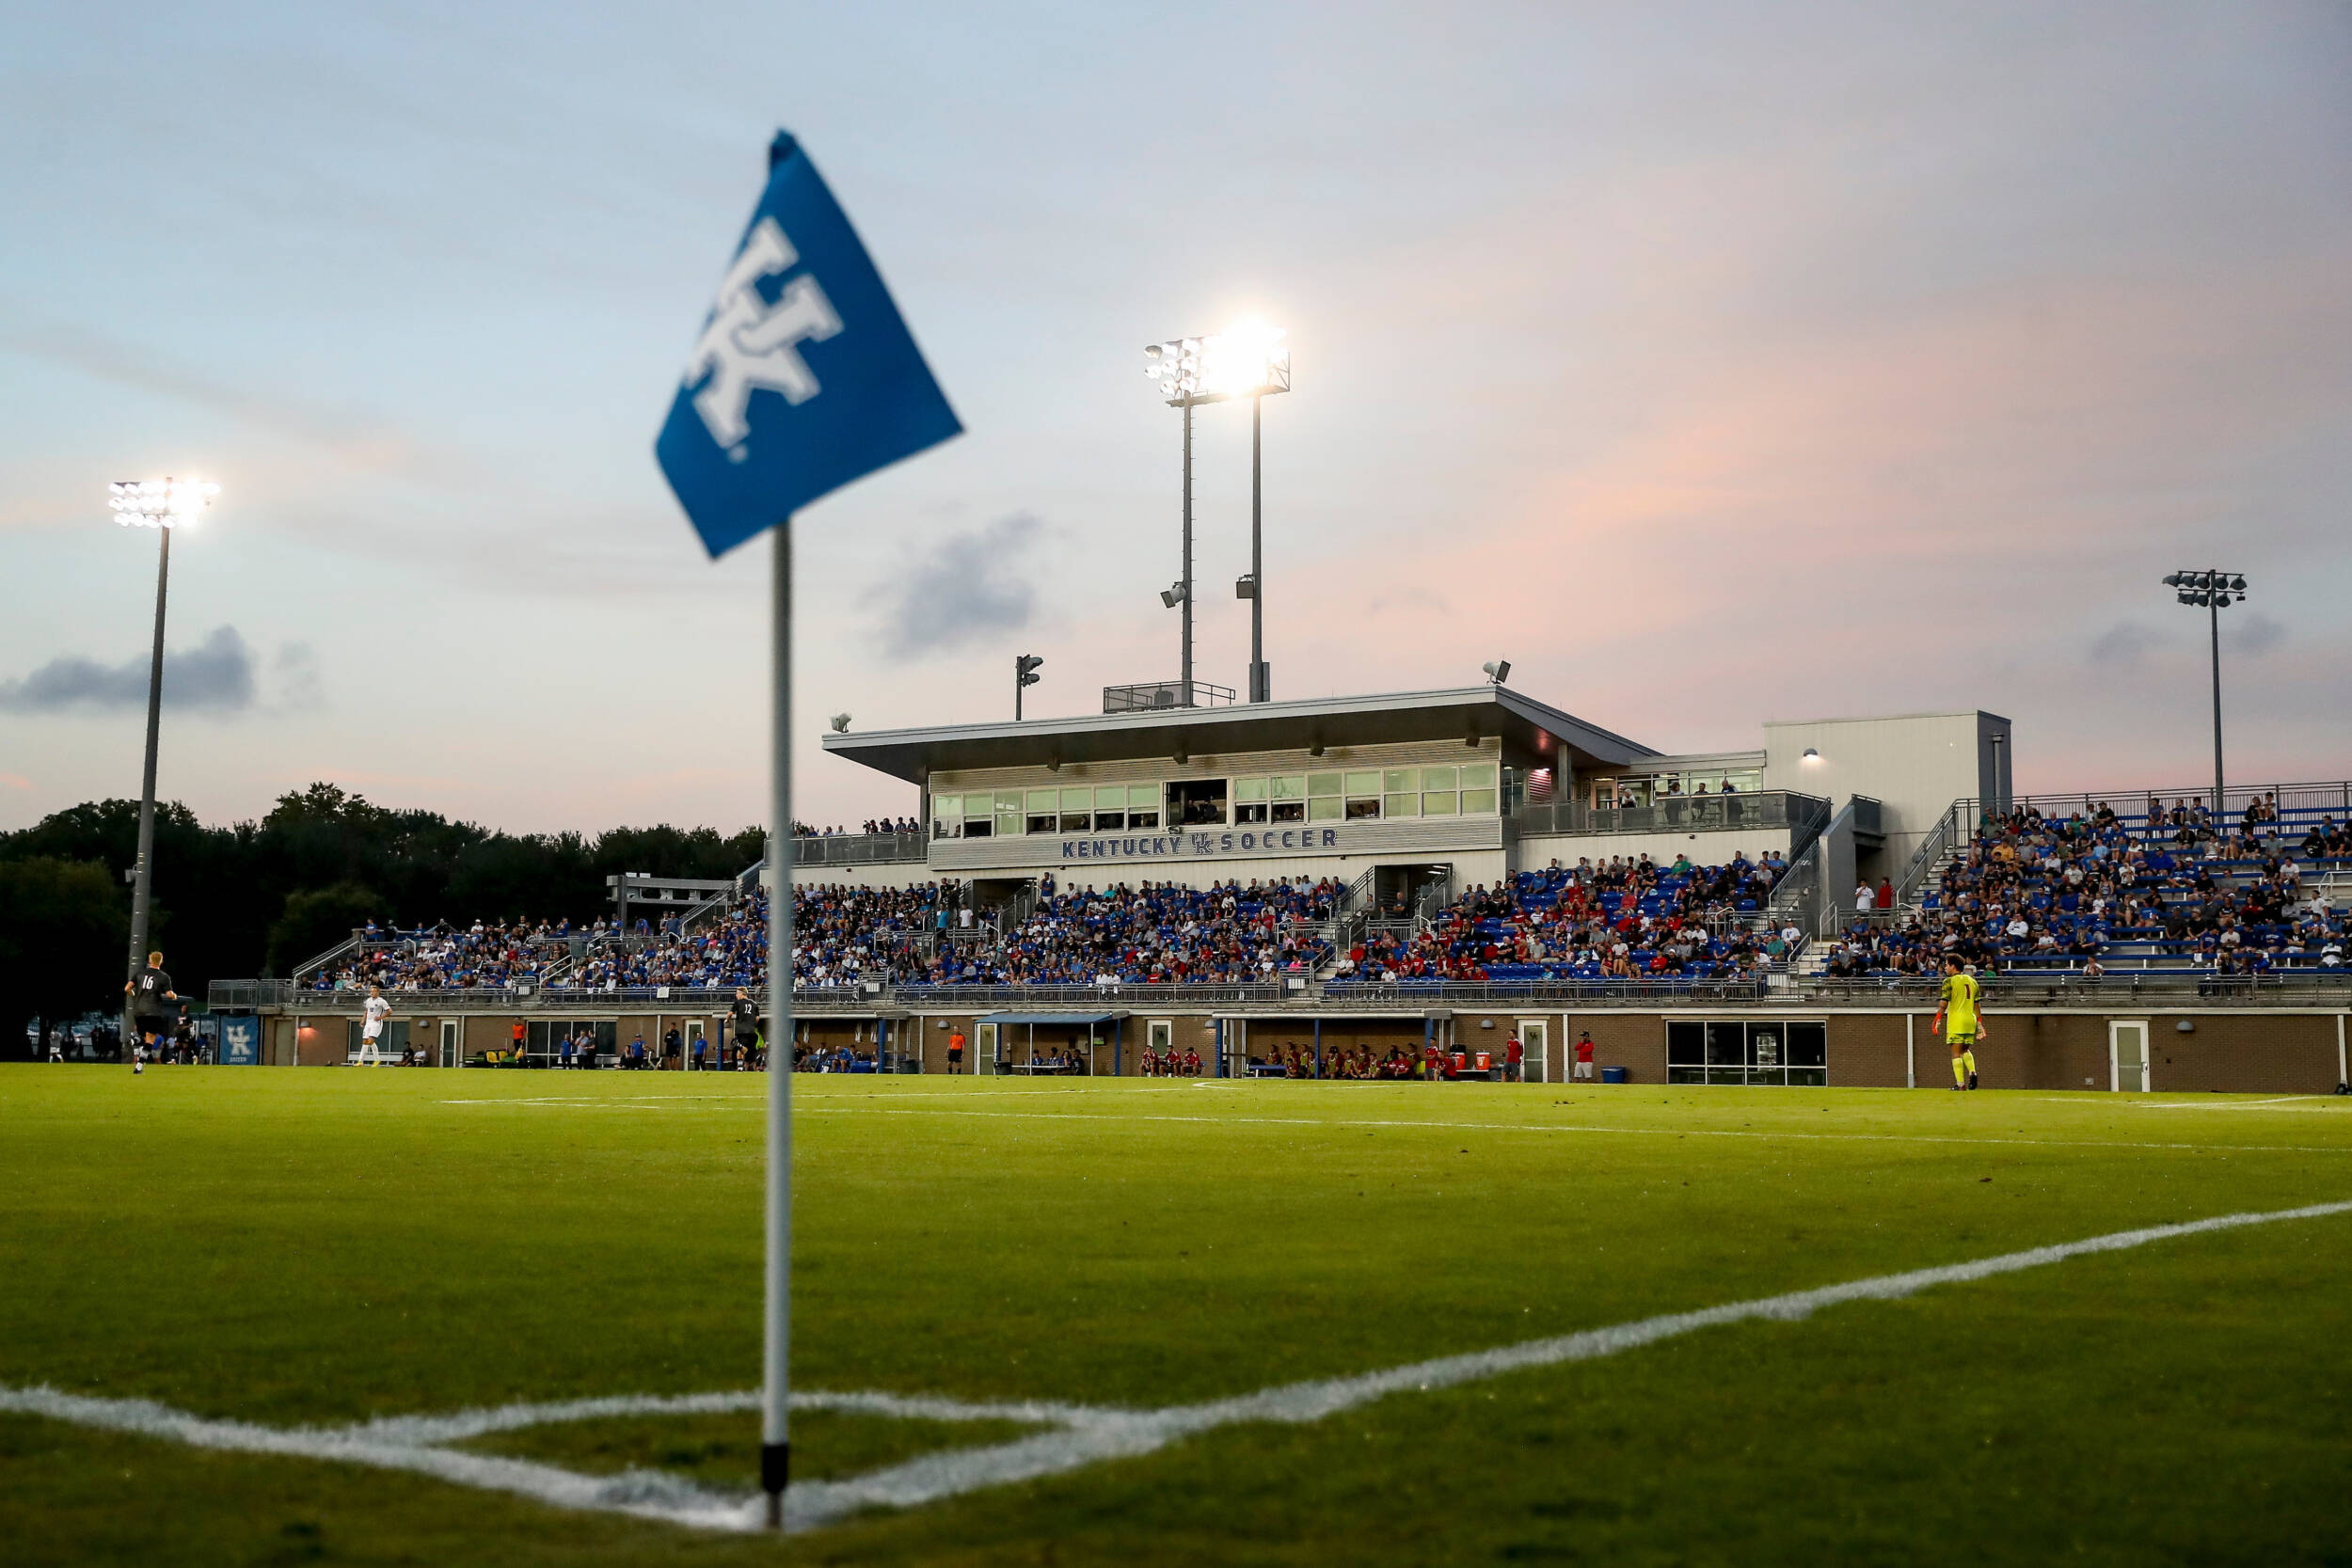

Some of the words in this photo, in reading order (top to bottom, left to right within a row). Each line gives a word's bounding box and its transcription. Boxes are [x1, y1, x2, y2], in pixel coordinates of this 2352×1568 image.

[685, 214, 846, 451] UK
[1061, 835, 1182, 859] KENTUCKY
[1191, 832, 1214, 856] UK
[1219, 828, 1338, 852] SOCCER
[142, 974, 154, 990] 16
[1963, 983, 1971, 1000] 1
[744, 1003, 753, 1014] 12
[226, 1025, 252, 1055] UK
